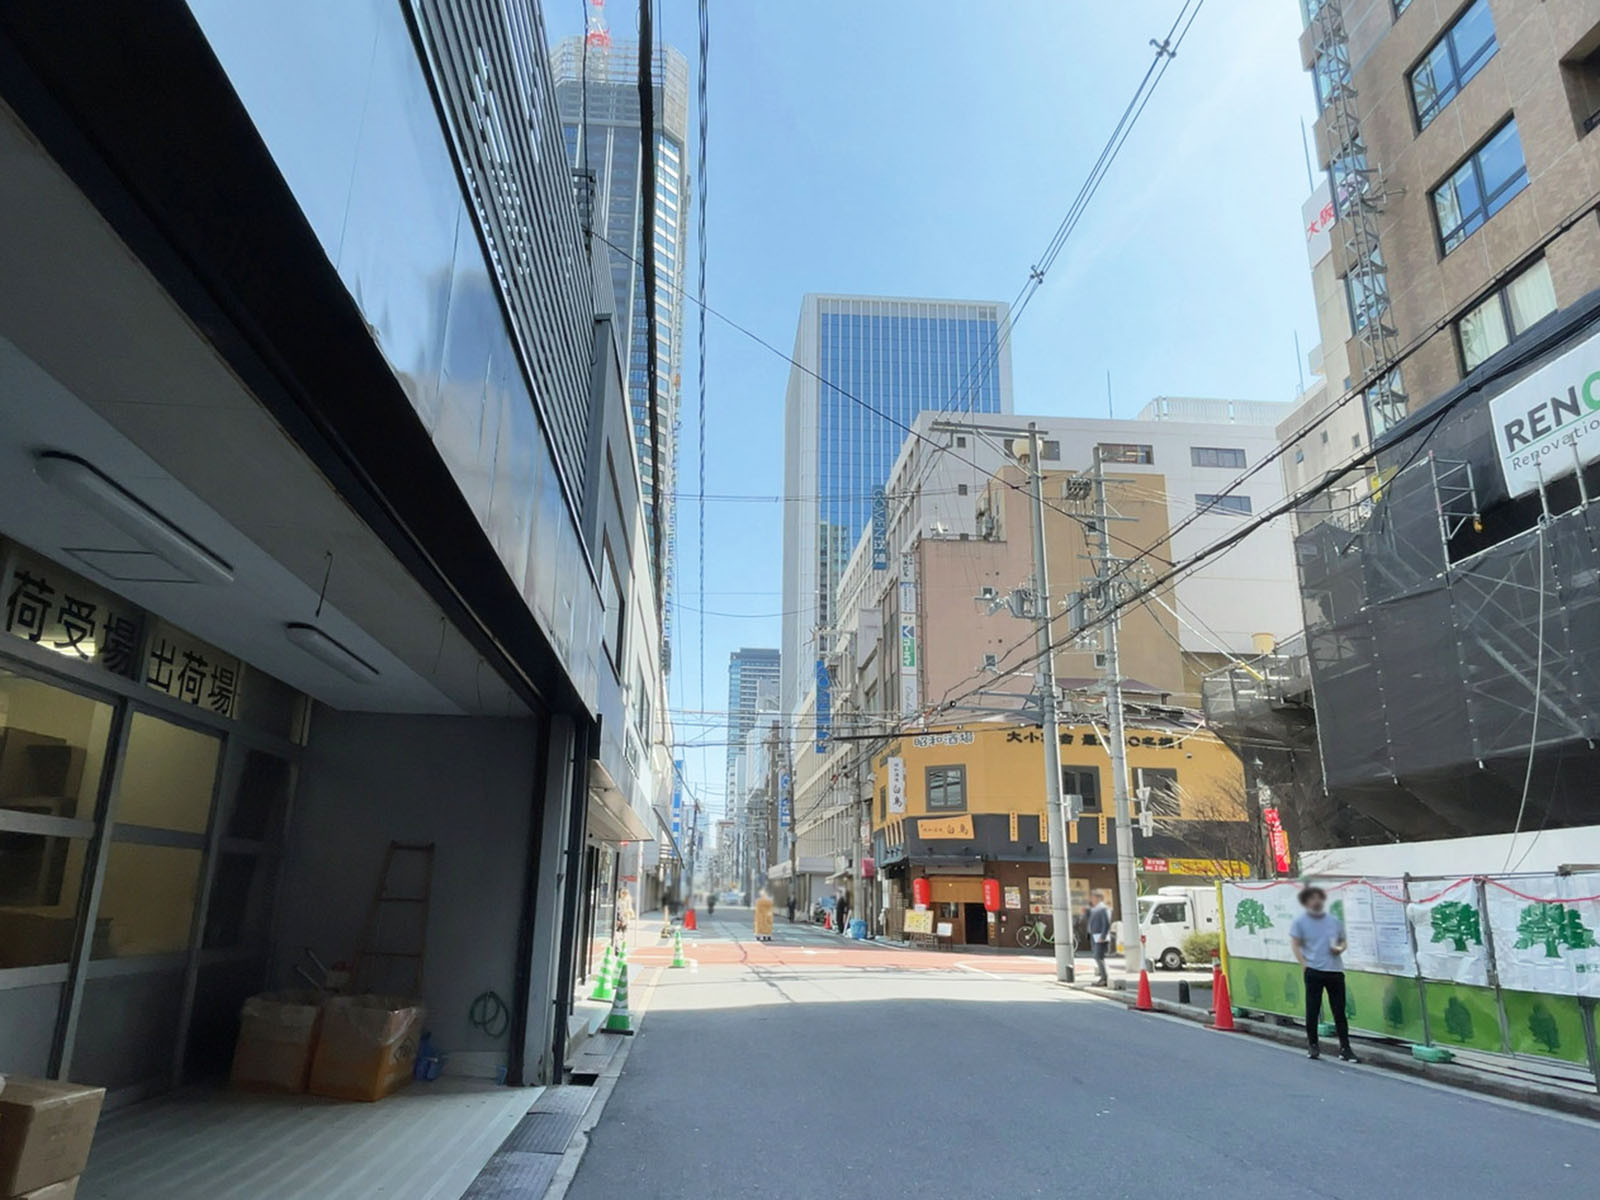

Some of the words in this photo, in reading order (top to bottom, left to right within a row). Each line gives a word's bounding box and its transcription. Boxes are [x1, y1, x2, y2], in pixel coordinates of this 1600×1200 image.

[7, 571, 136, 678] 荷受場
[147, 639, 234, 715] 出荷場
[912, 731, 975, 748] 昭和酒場
[1006, 731, 1073, 745] 大小会
